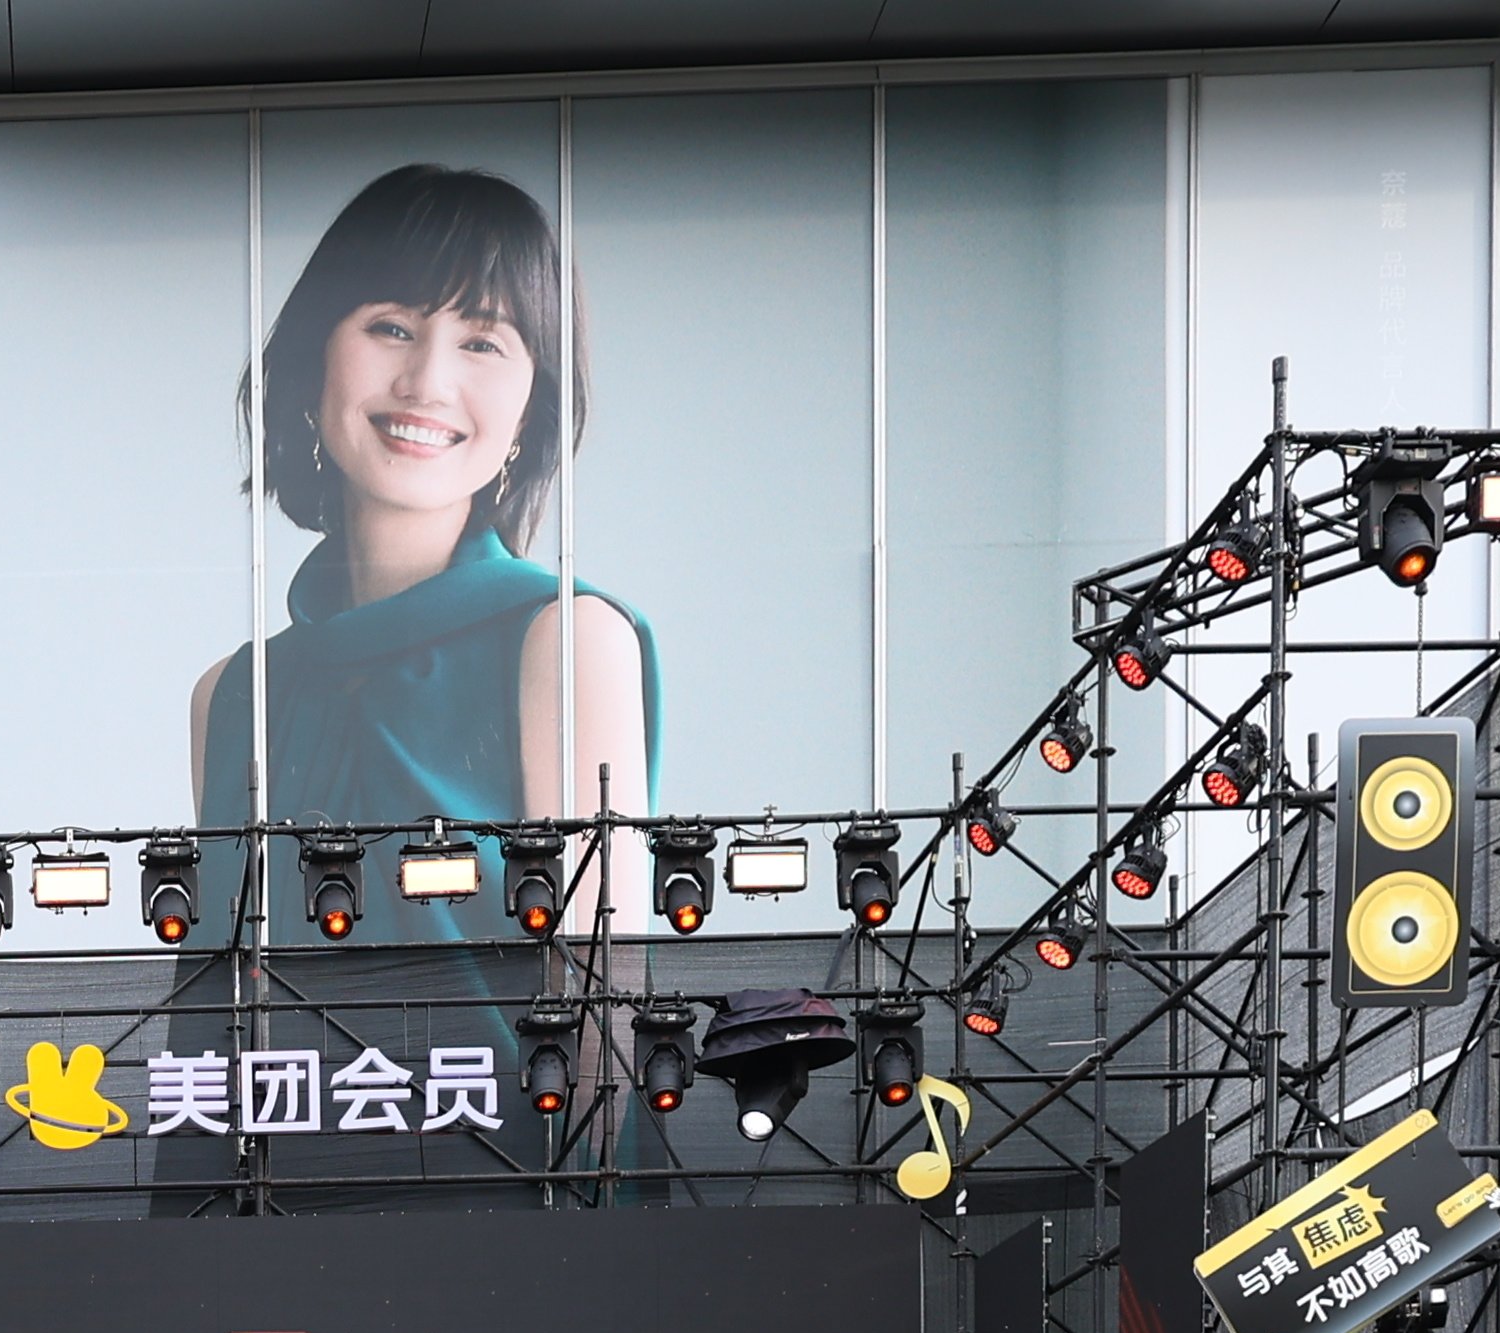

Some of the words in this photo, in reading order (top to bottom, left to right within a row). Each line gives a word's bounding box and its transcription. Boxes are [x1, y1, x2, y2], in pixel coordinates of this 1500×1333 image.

[147, 1047, 504, 1136] 美团会员
[1237, 1203, 1372, 1297] 与其焦虑
[1297, 1226, 1430, 1323] 不如高歌
